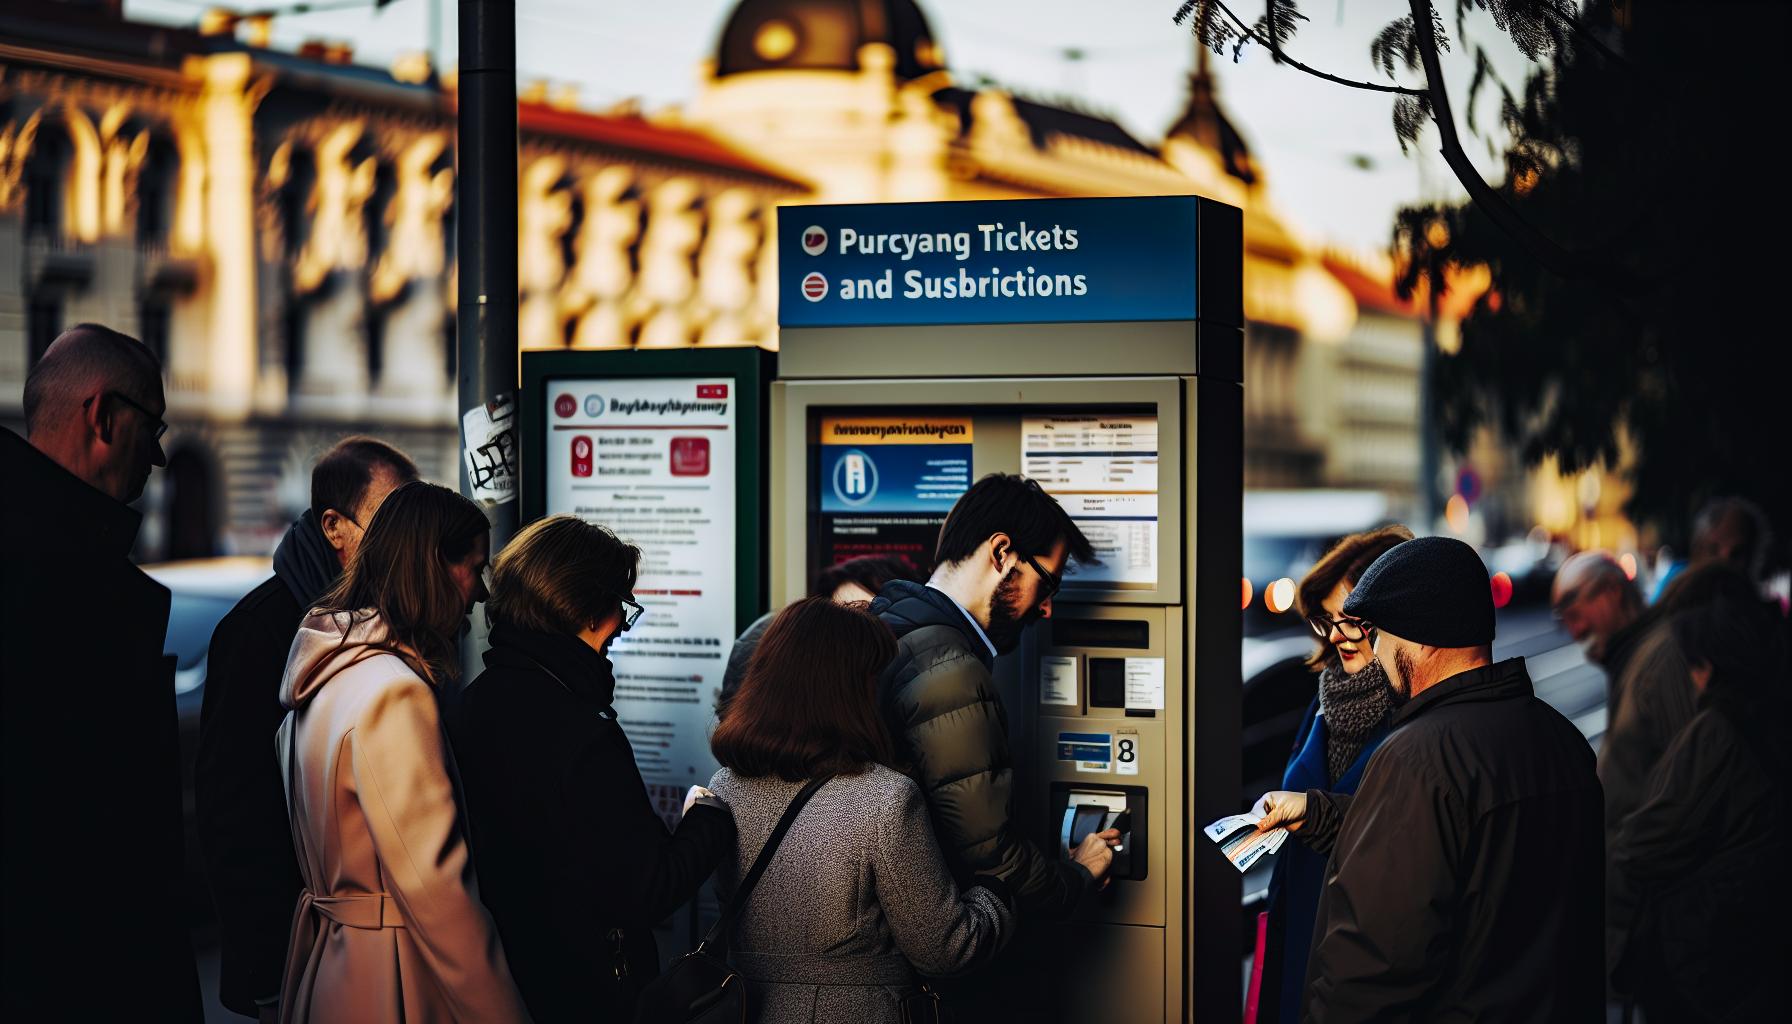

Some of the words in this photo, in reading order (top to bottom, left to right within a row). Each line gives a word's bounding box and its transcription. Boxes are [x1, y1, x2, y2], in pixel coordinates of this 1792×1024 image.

[839, 228, 970, 261] Purcyang
[977, 221, 1079, 252] Tickets
[839, 269, 893, 300] and
[903, 266, 1088, 299] Susbrictions
[1117, 738, 1135, 763] 8
